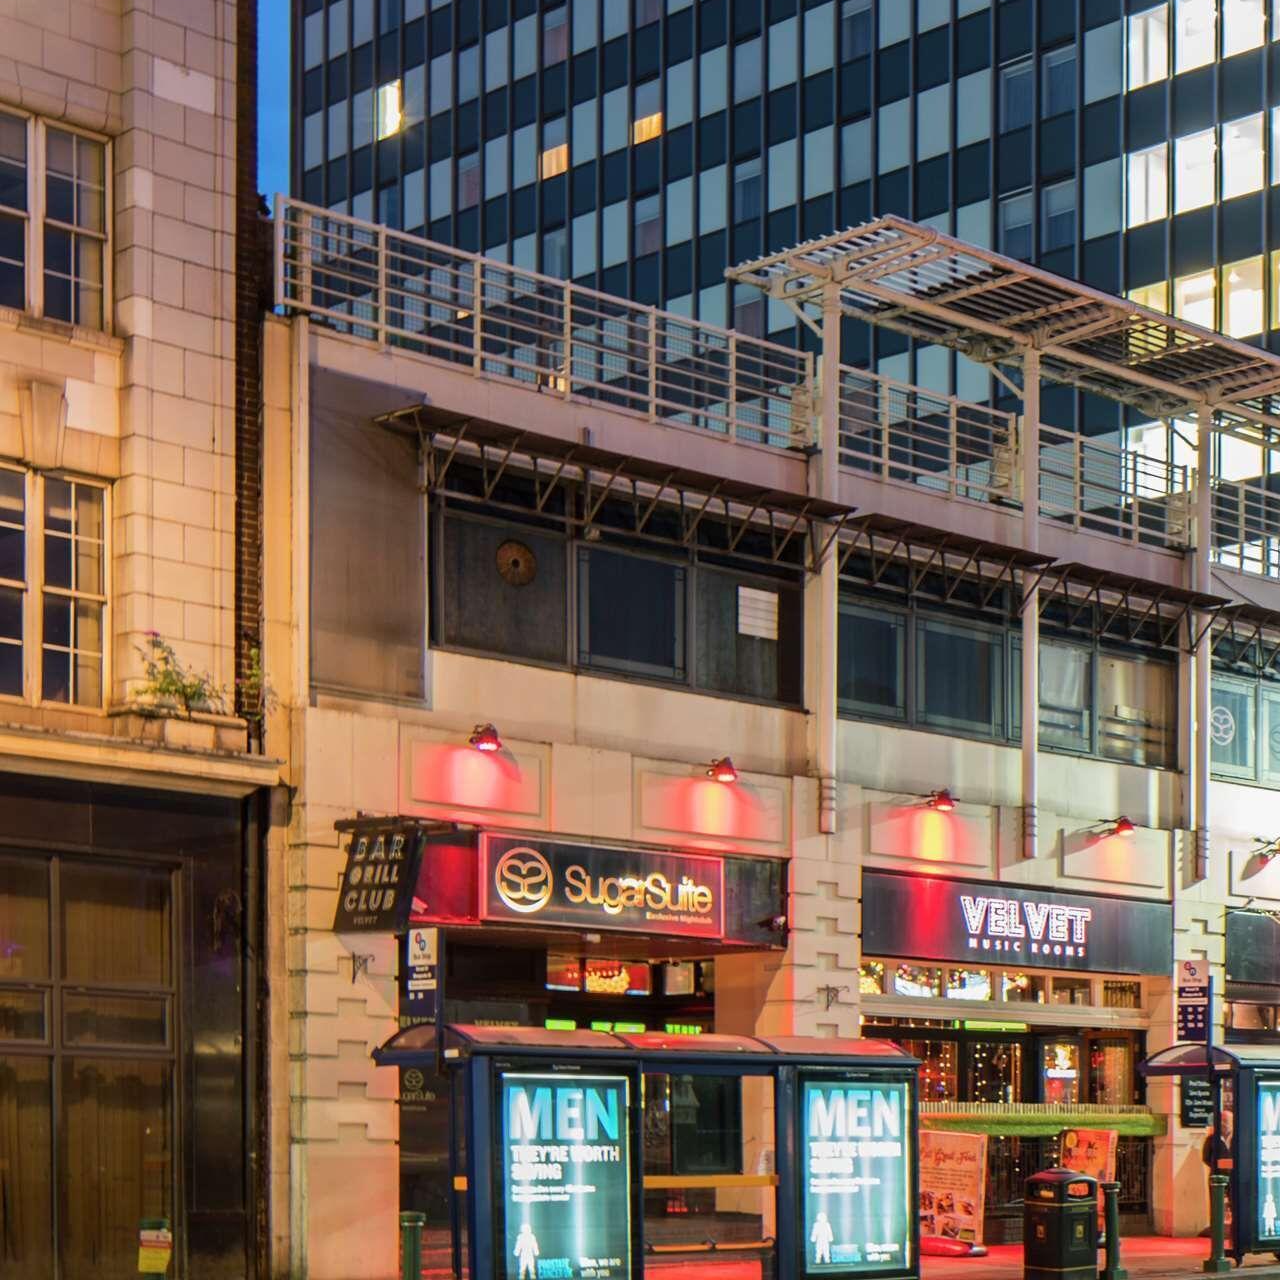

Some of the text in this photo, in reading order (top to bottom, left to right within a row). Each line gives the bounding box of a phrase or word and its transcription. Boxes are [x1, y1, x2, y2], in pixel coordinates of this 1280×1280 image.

[353, 833, 406, 861] BAR
[349, 863, 400, 886] GRILL
[565, 864, 713, 915] SugarSuite
[343, 889, 396, 913] CLUB
[960, 895, 1092, 944] VELVET
[968, 938, 1086, 958] MUSIC ROOMS
[509, 1086, 620, 1141] MEN
[809, 1088, 901, 1138] MEN
